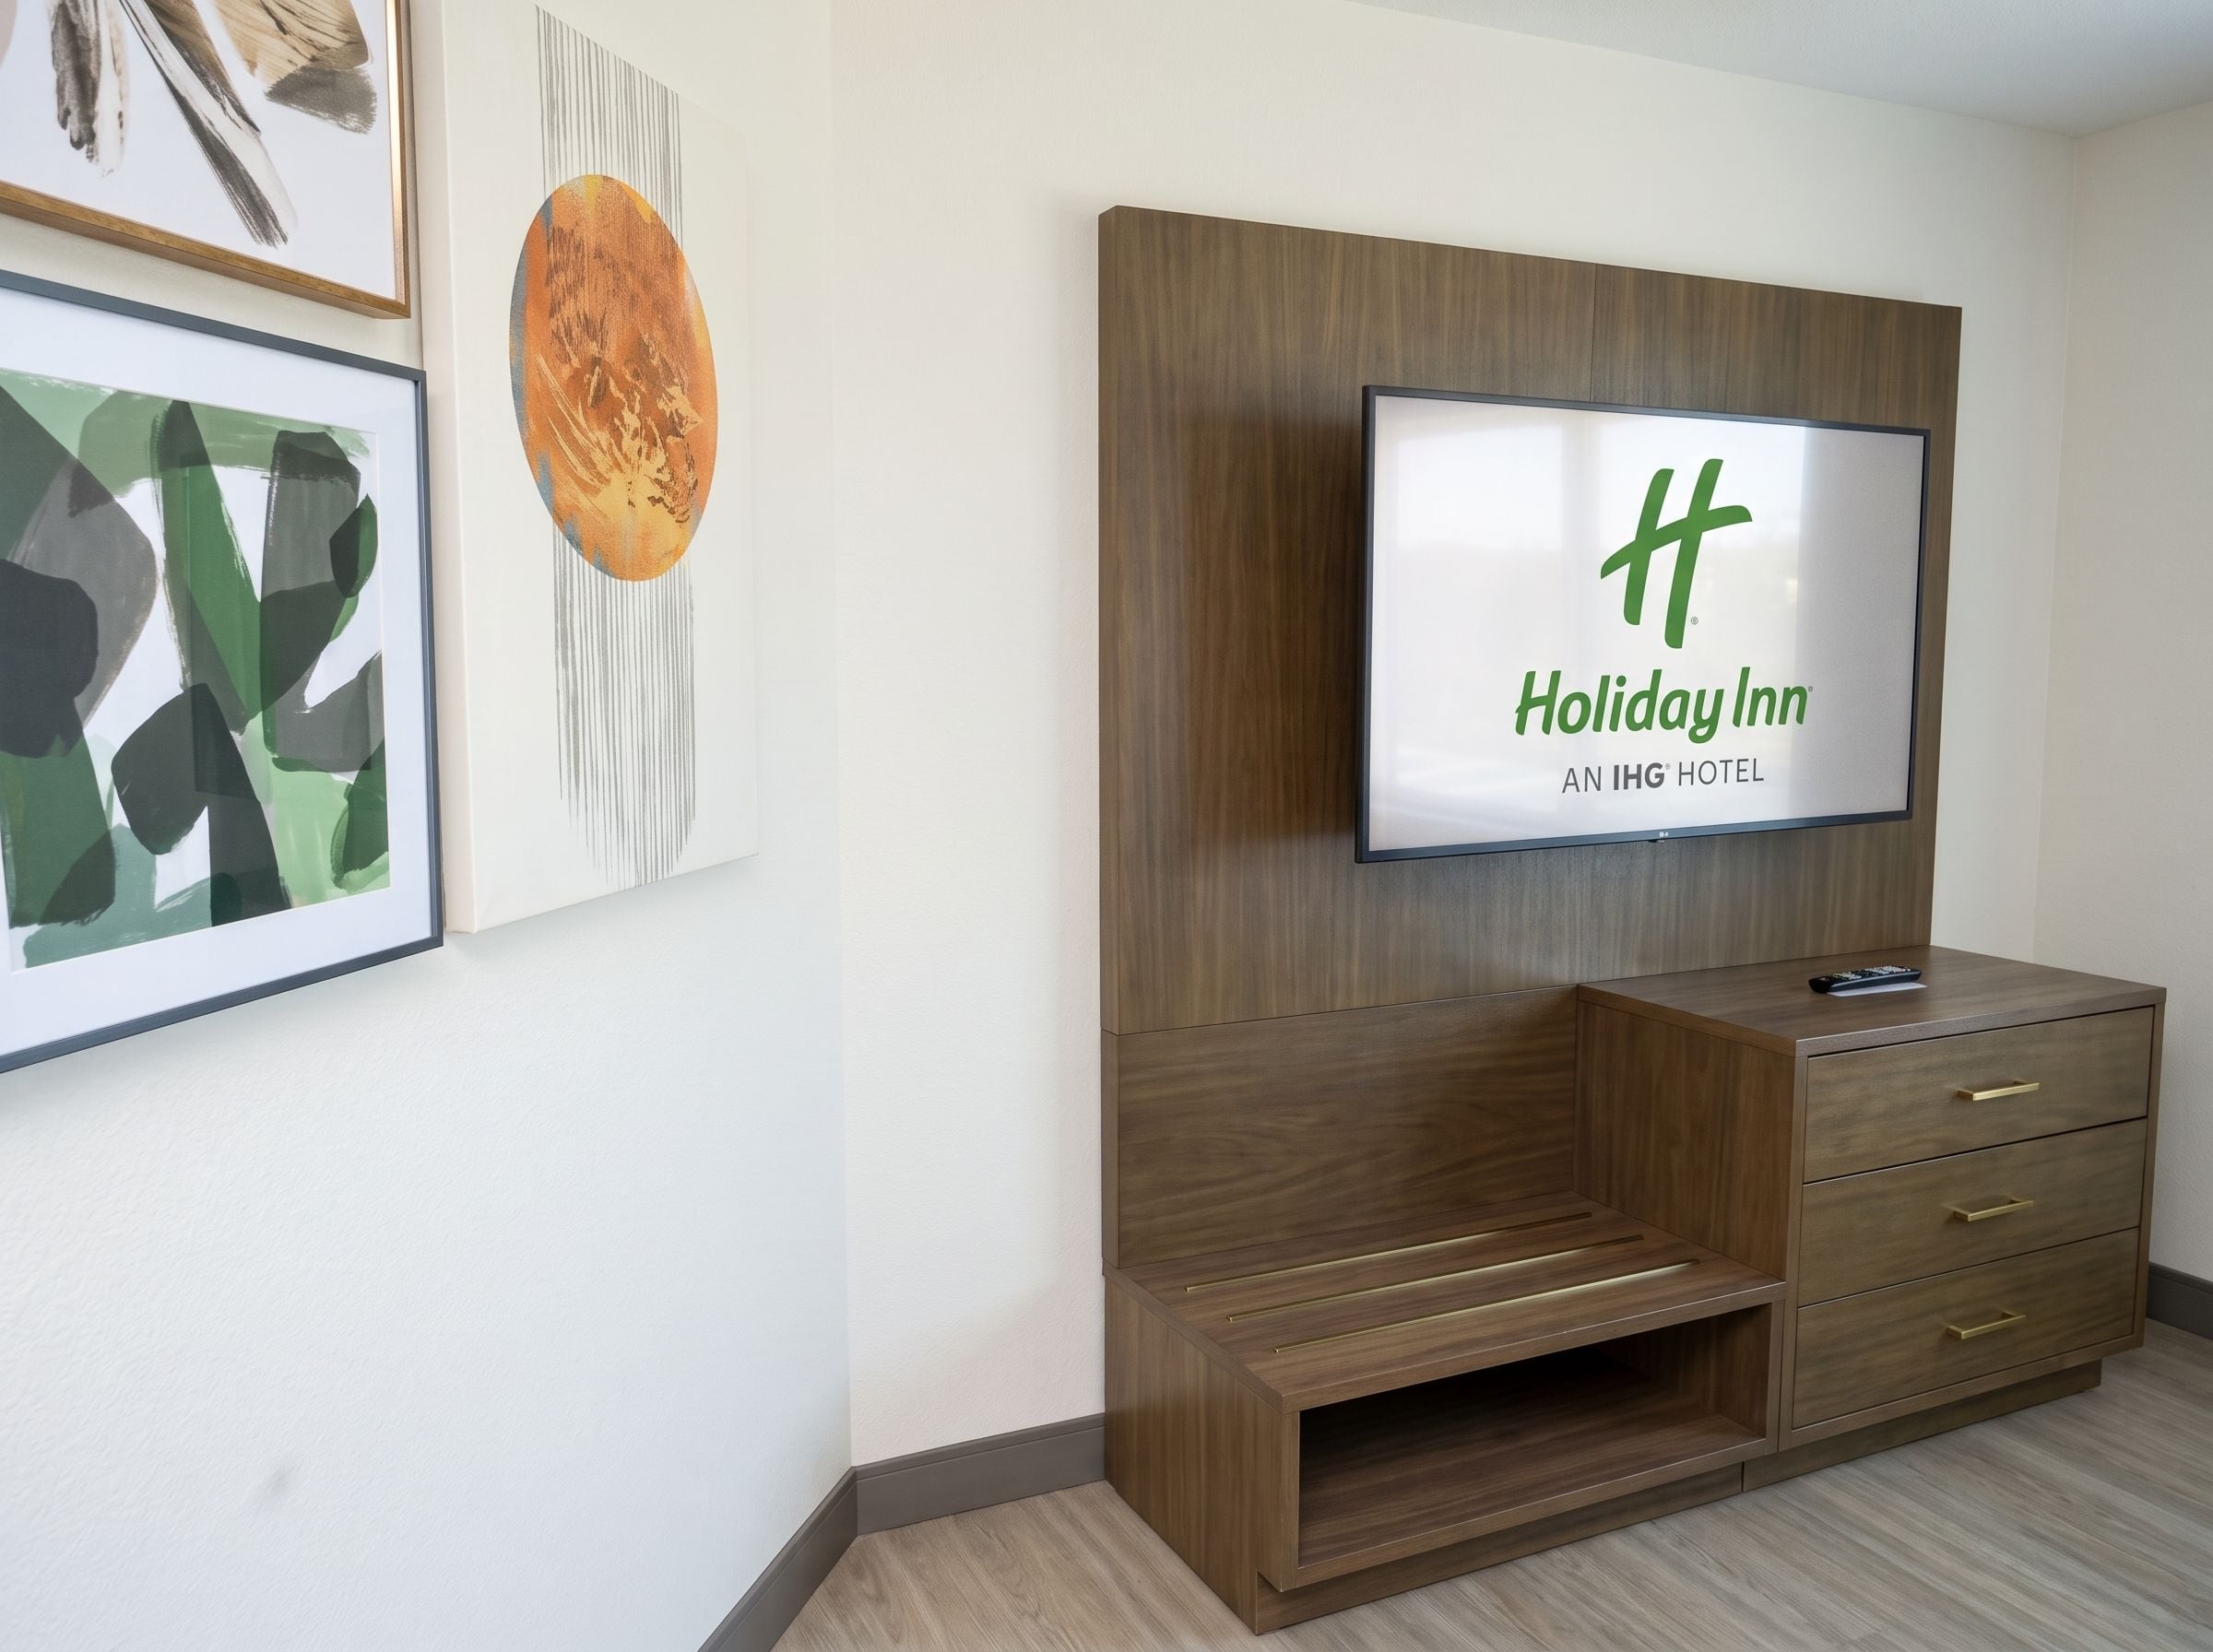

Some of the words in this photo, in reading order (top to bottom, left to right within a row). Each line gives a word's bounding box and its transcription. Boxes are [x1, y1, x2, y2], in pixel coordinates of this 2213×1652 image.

[1600, 458, 1753, 650] H
[1514, 668, 1724, 745] Holiday
[1732, 666, 1808, 728] Inn
[1561, 764, 1603, 794] AN
[1613, 761, 1665, 792] IHG
[1678, 758, 1765, 786] HOTEL
